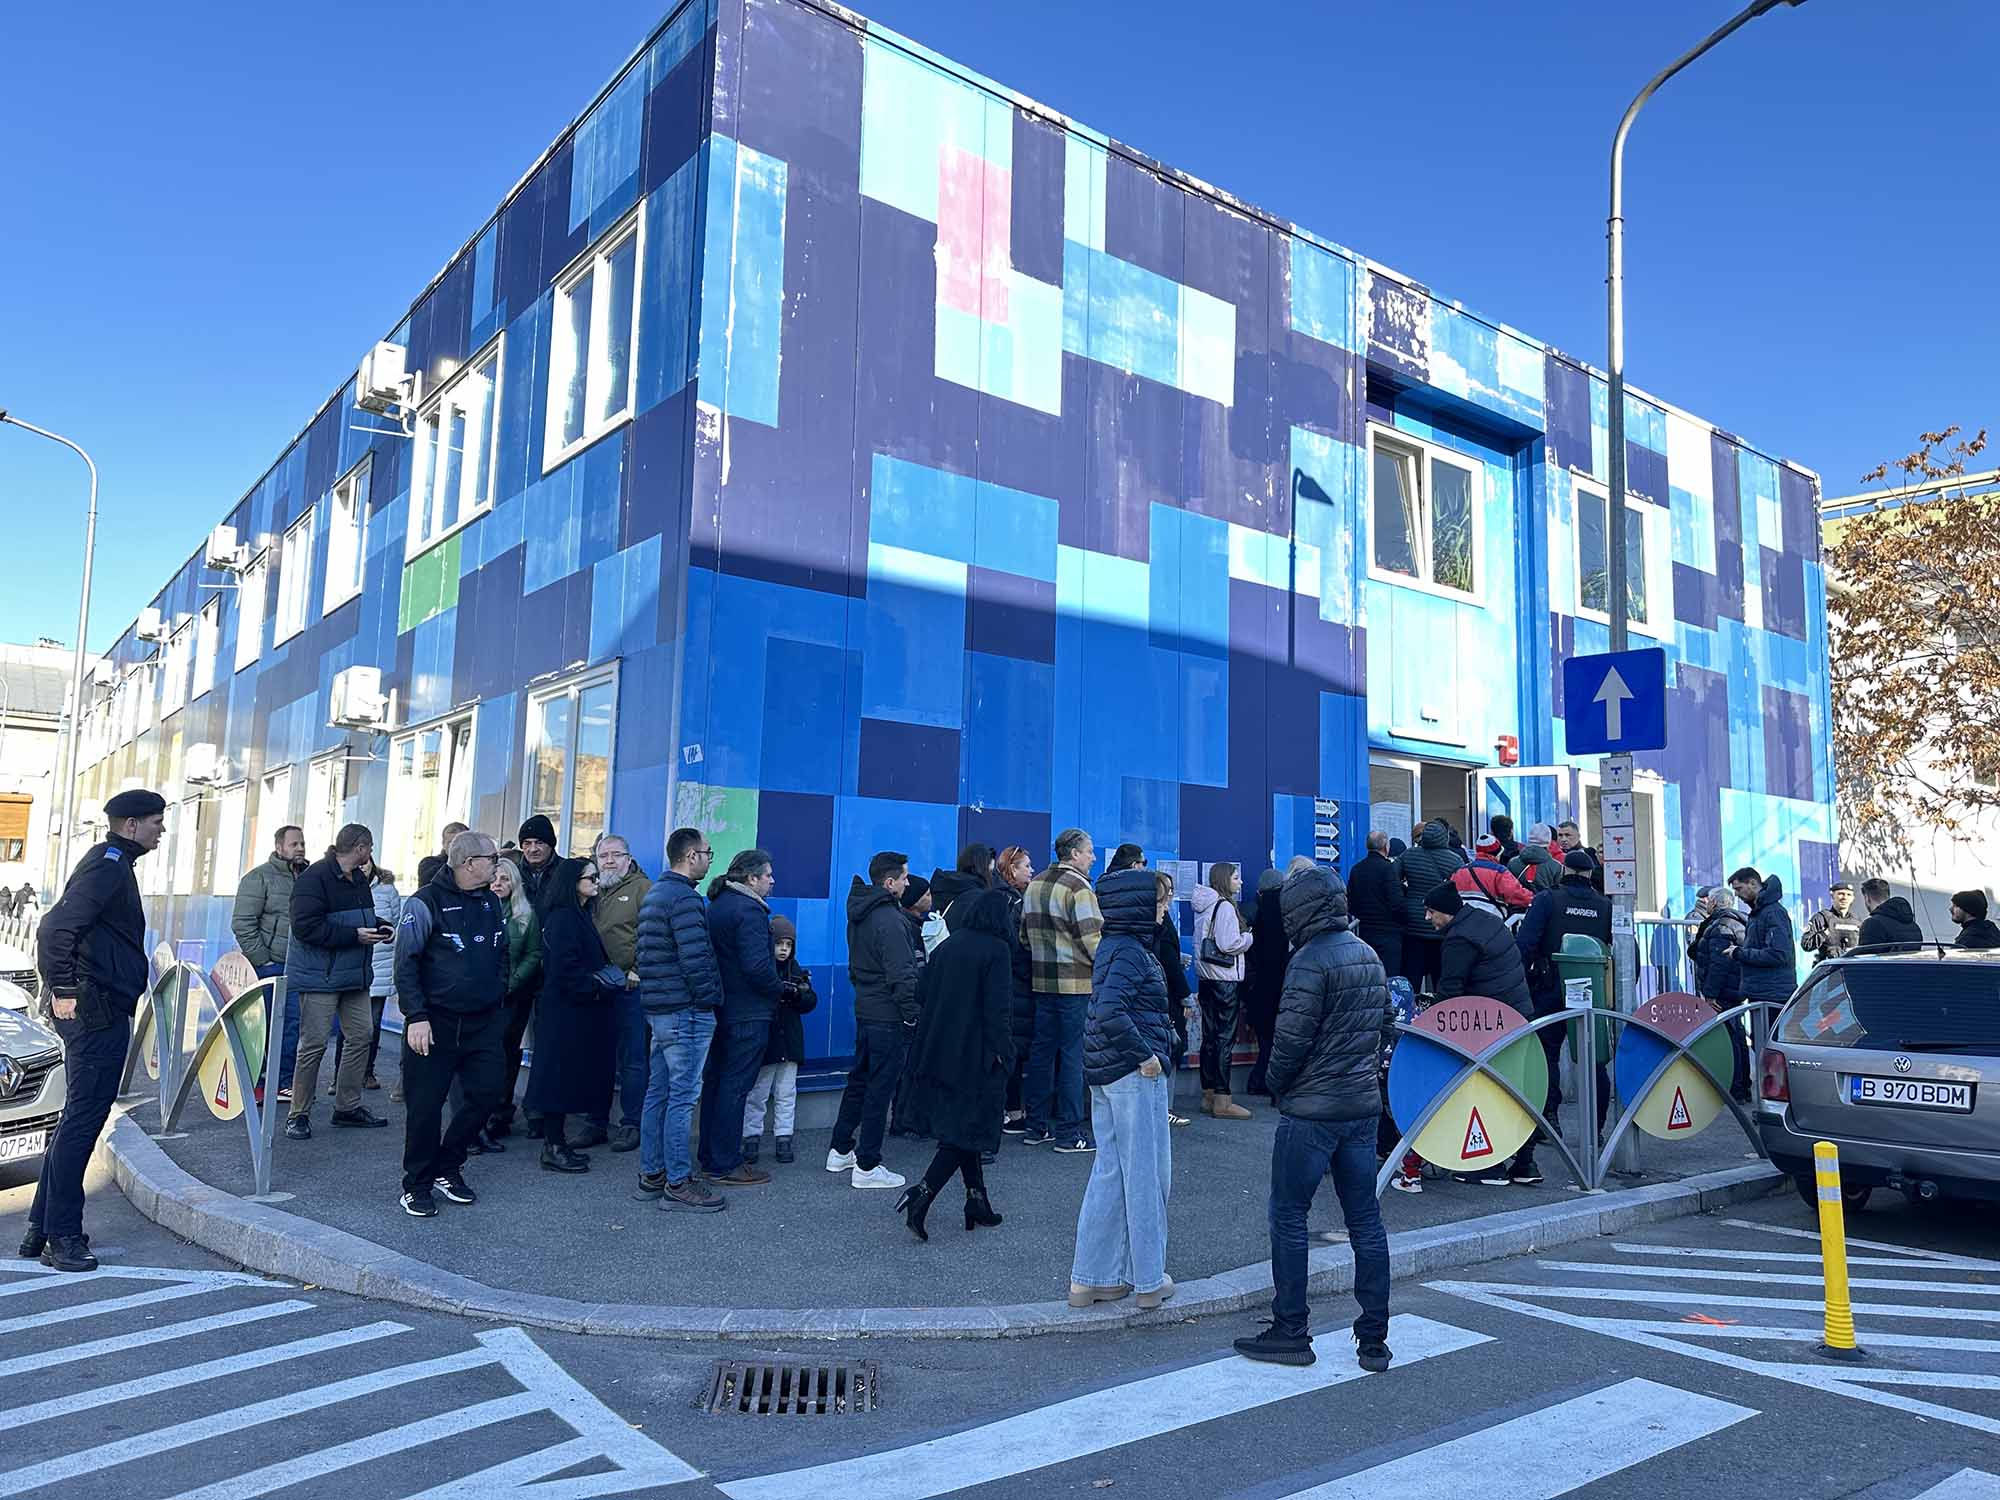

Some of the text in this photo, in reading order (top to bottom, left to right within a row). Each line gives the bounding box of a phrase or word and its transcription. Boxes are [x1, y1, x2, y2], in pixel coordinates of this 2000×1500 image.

[1437, 1009, 1504, 1032] SCOALA
[1862, 1080, 1965, 1106] B 970 BDM
